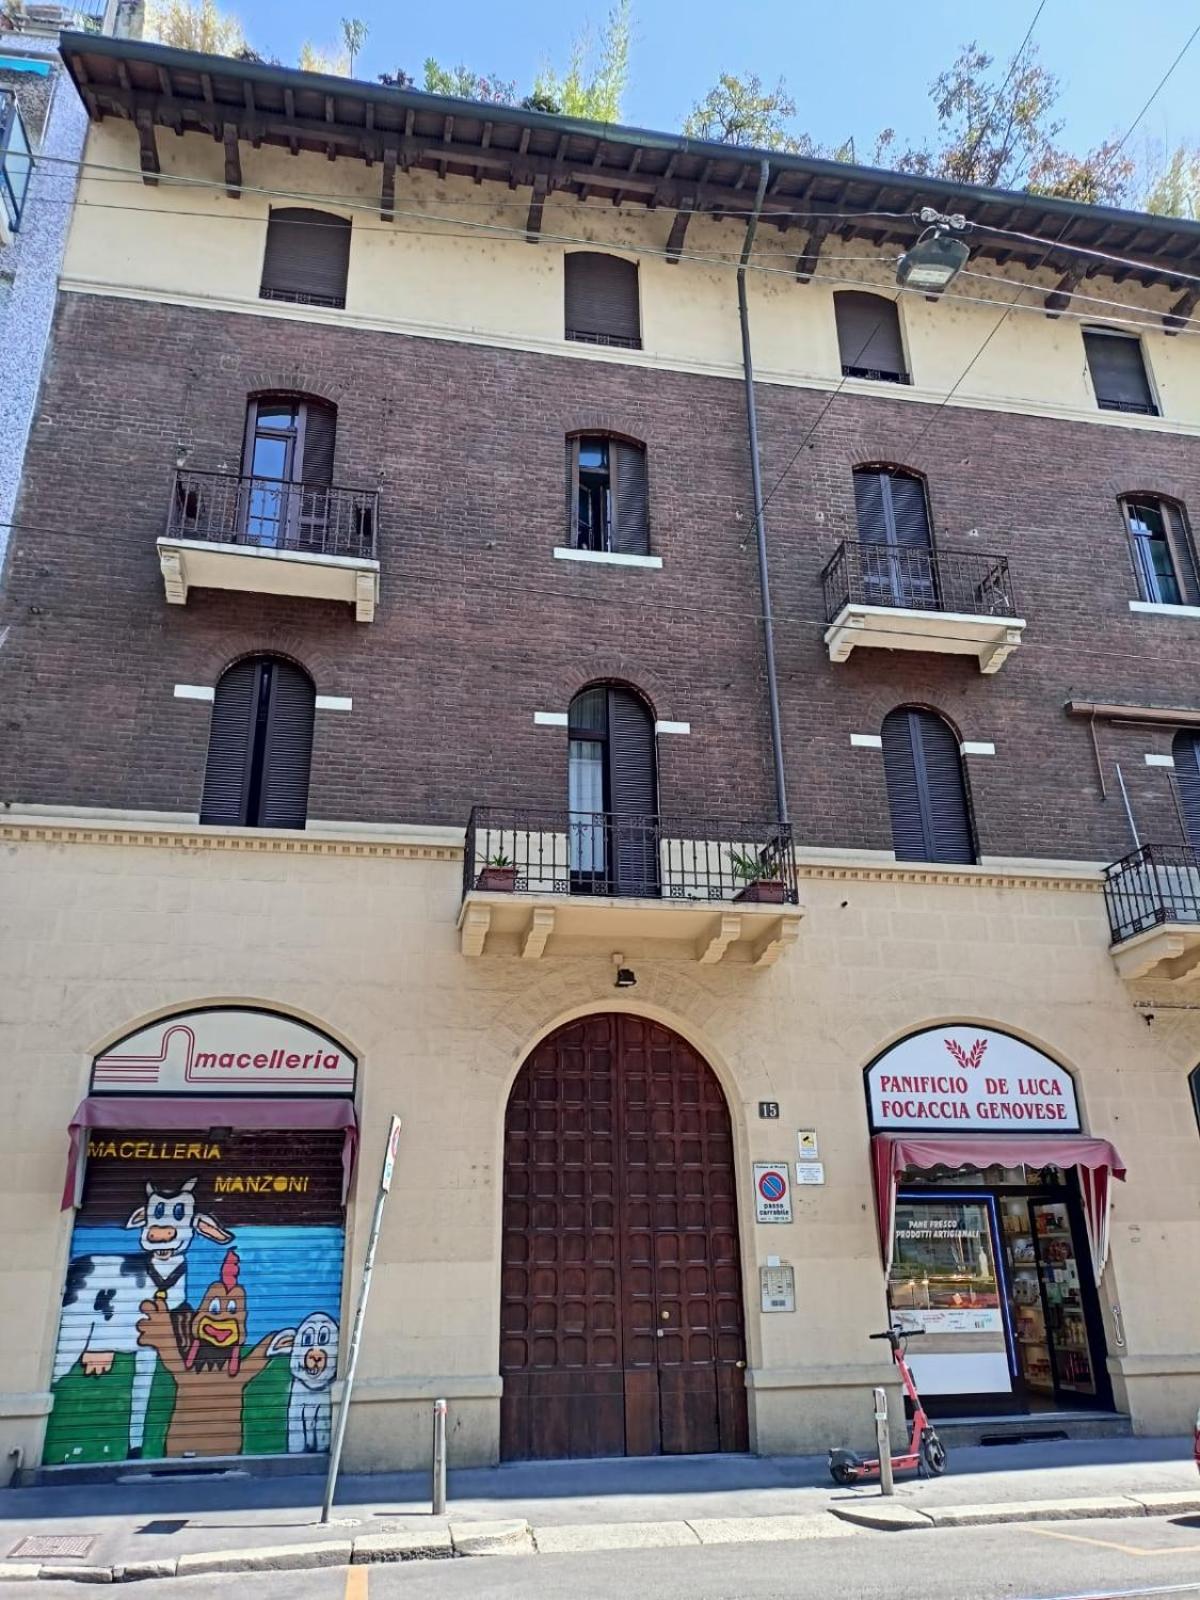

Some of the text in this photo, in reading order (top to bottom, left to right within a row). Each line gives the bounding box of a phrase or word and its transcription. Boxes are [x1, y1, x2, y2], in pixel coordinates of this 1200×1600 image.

[194, 1050, 340, 1069] macelleria
[880, 1075, 1062, 1096] PANIFICIO DE LUCA
[763, 1104, 777, 1117] 15
[881, 1100, 1067, 1120] FOCACCIA GENOVESE
[87, 1141, 221, 1159] MACELLERIA
[214, 1176, 309, 1193] MANZONI
[908, 1220, 958, 1229] PANE FRESCO
[895, 1230, 979, 1239] PRODOTTI ARTIGIANALI
